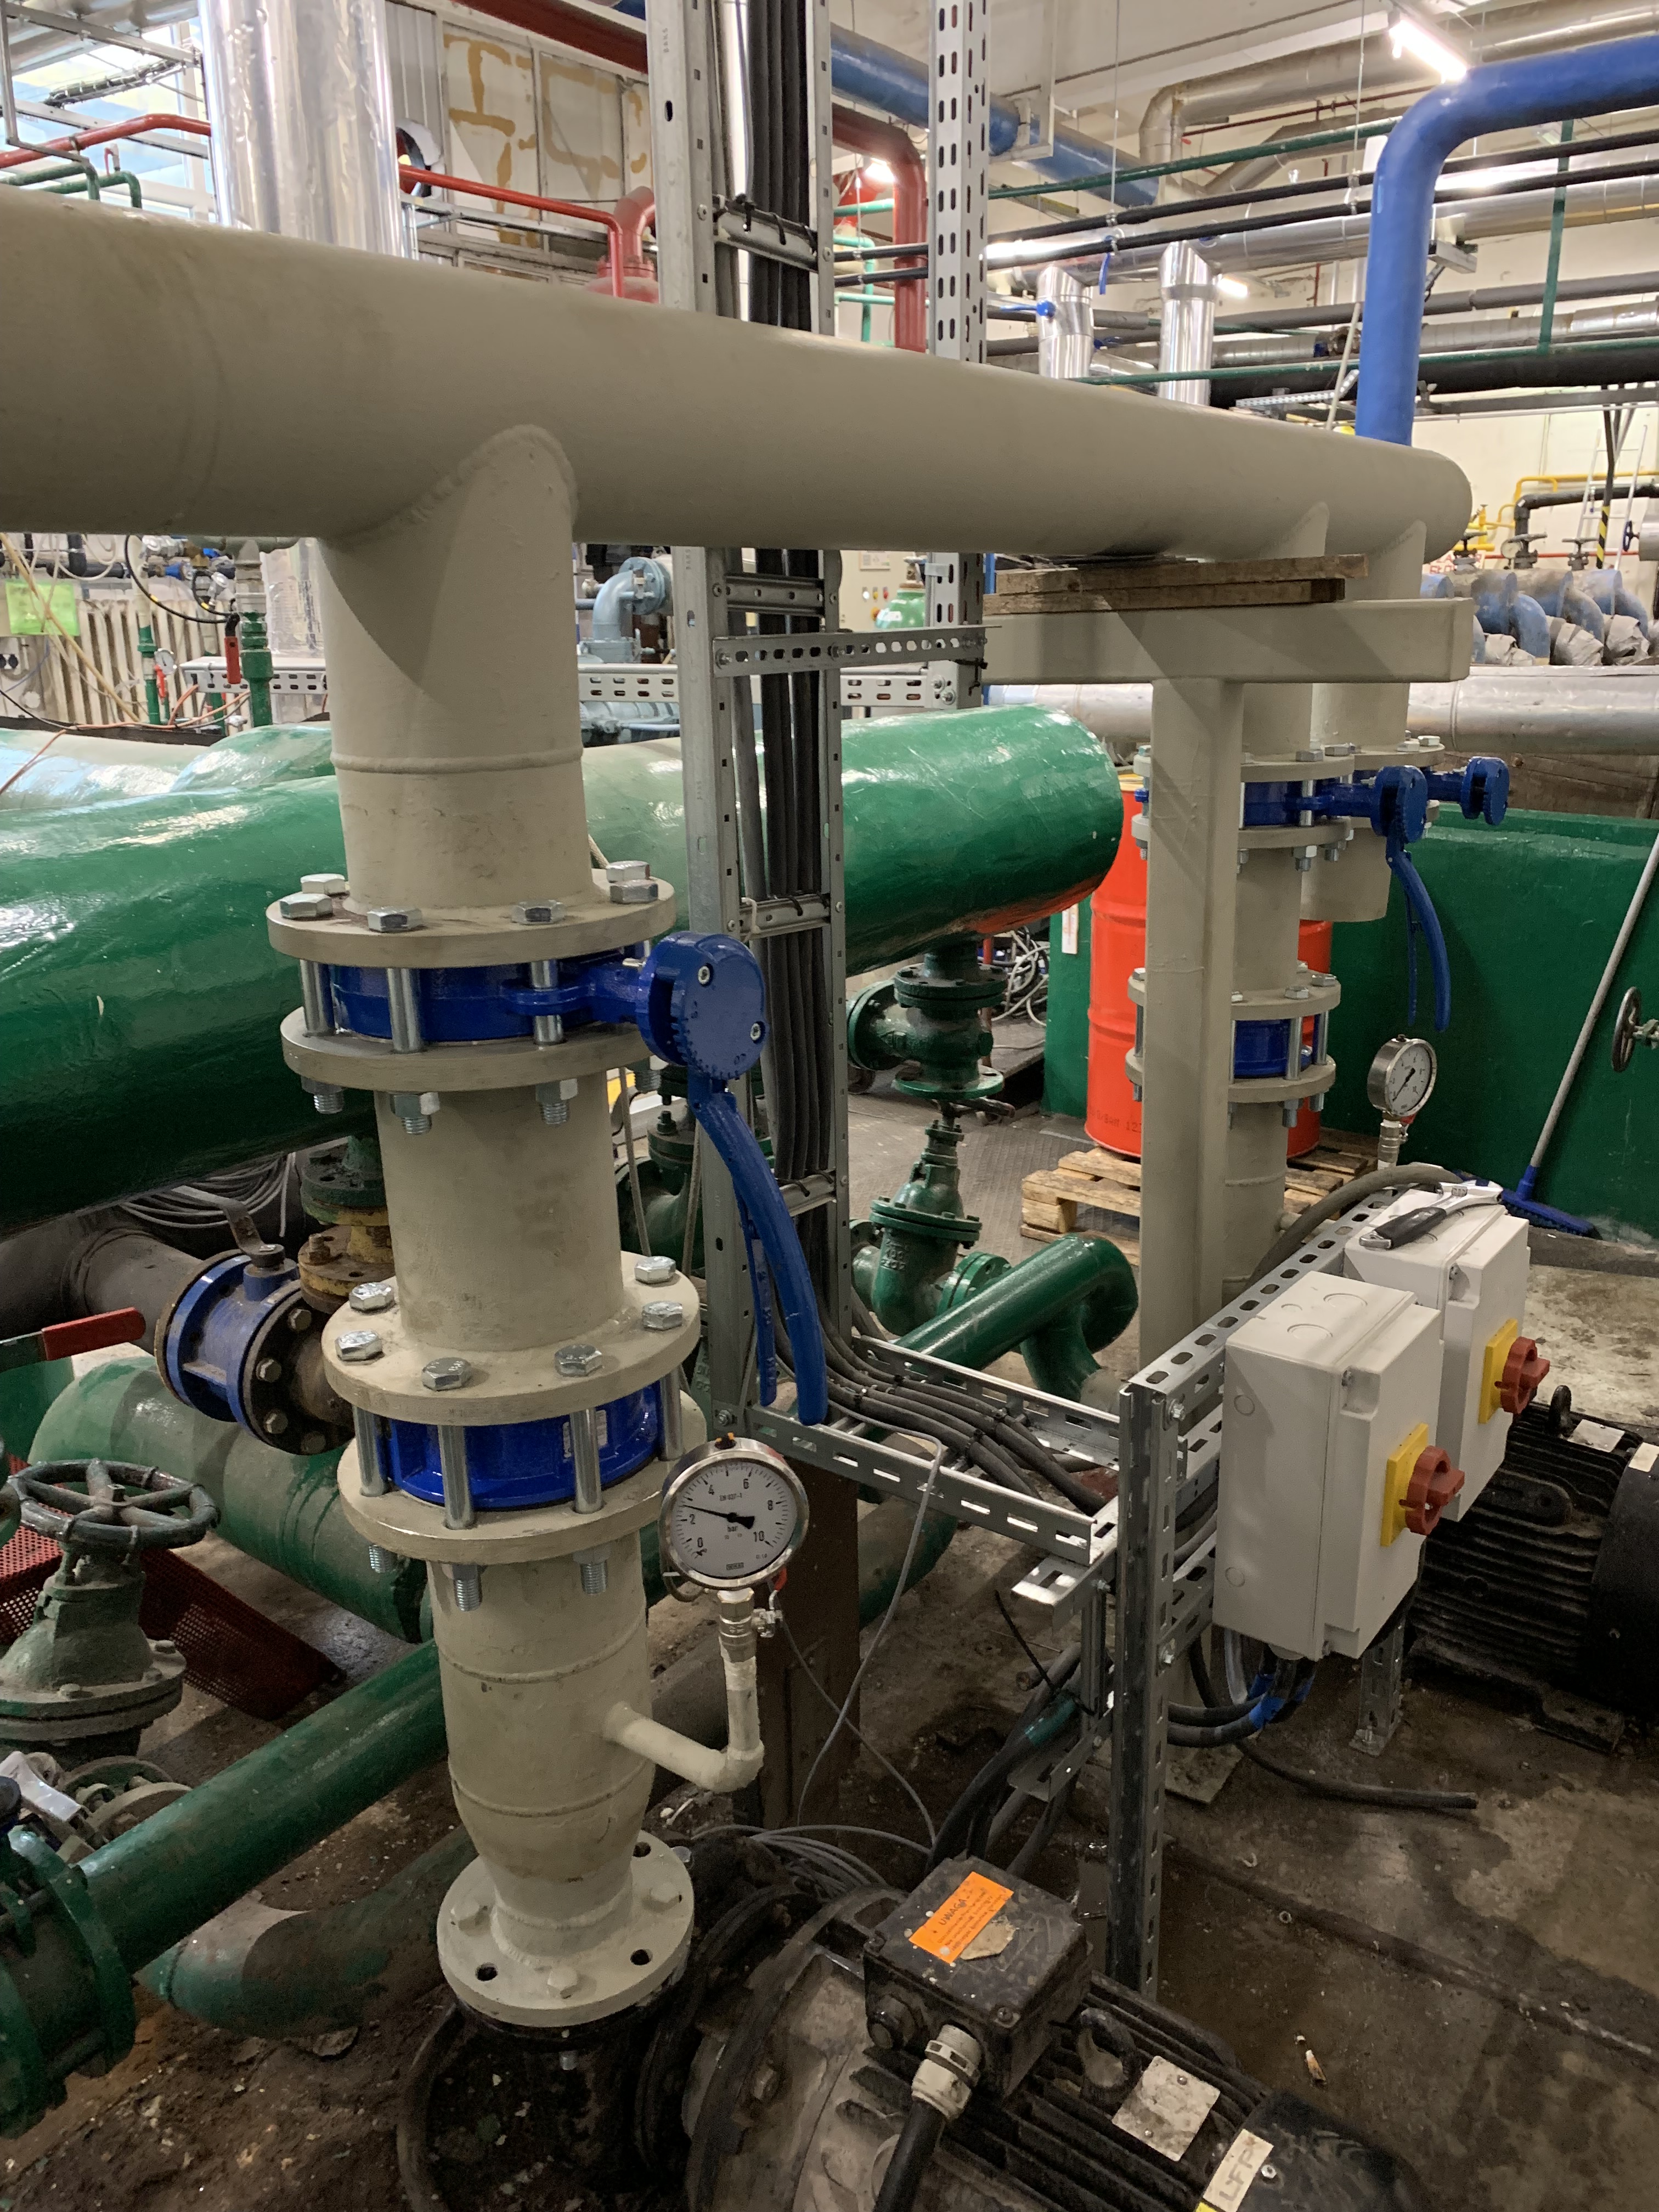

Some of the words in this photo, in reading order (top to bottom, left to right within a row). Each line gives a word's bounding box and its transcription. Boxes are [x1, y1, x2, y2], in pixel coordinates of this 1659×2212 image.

[743, 1479, 749, 1489] 6
[708, 1485, 715, 1496] 4
[767, 1500, 773, 1511] 8
[689, 1514, 696, 1525] 2
[753, 1531, 765, 1542] 10
[697, 1537, 703, 1548] 0
[938, 1898, 967, 1926] UWAGA
